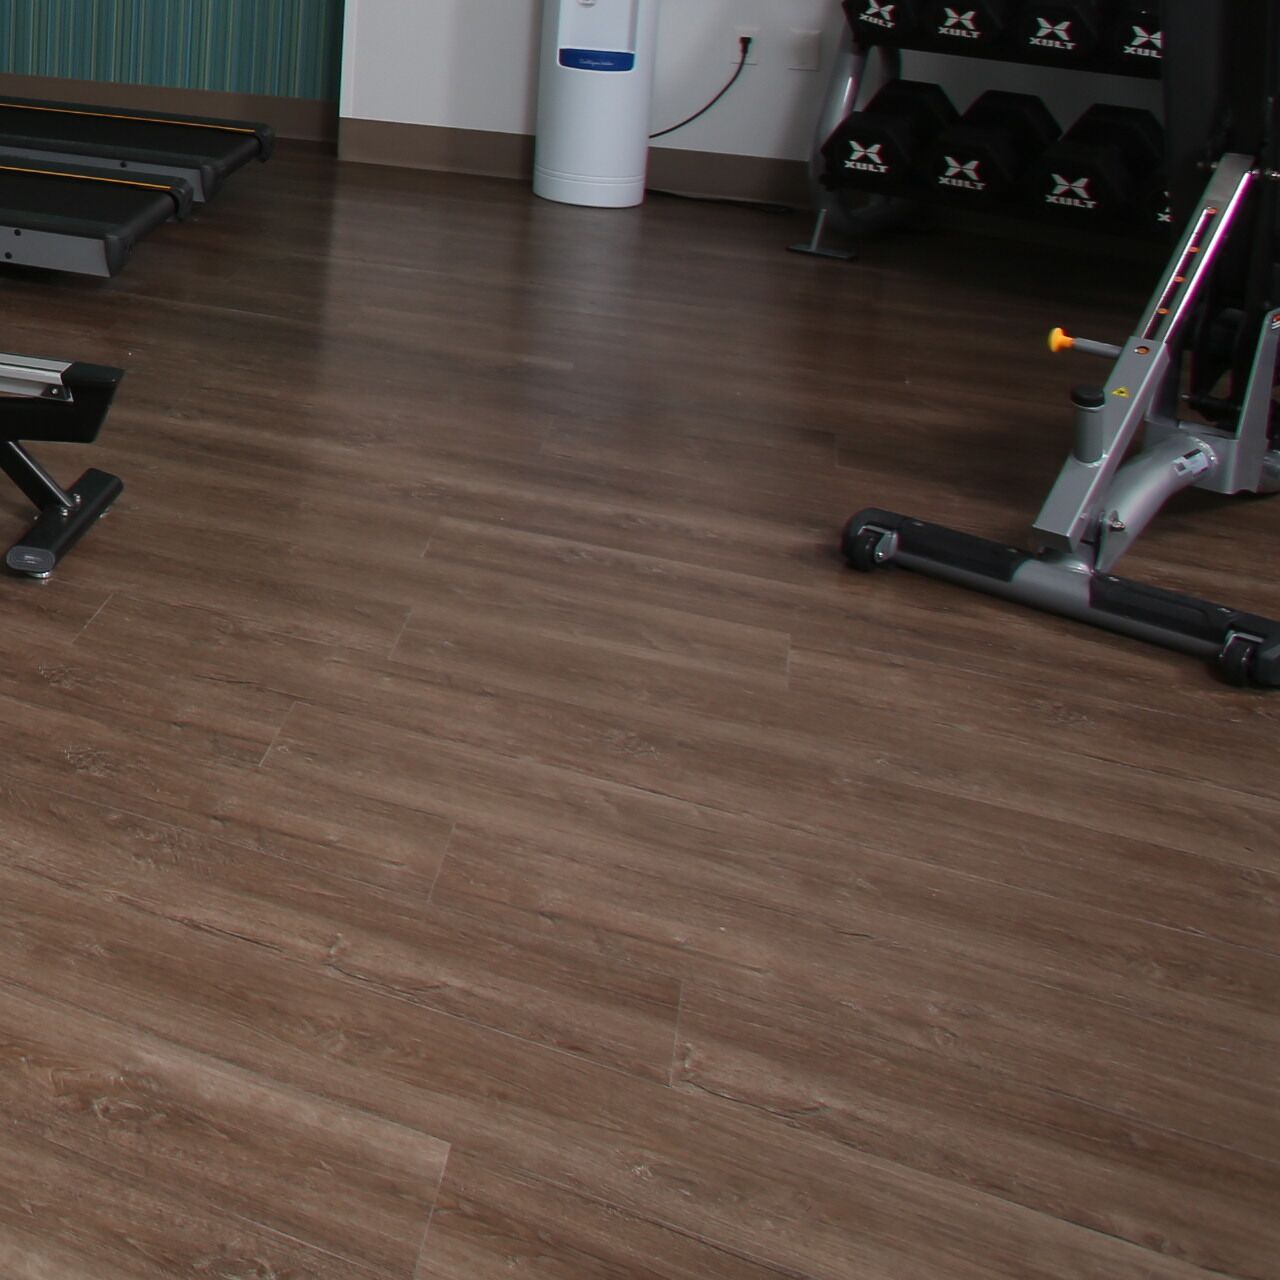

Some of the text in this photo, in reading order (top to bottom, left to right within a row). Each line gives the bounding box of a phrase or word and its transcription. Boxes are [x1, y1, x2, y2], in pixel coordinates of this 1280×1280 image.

[860, 14, 895, 28] XULT
[938, 27, 981, 38] XULT
[1029, 37, 1076, 50] XULT
[1123, 46, 1162, 58] XUL
[845, 161, 889, 174] XULT
[939, 177, 986, 190] XULT
[1045, 194, 1099, 208] XULT
